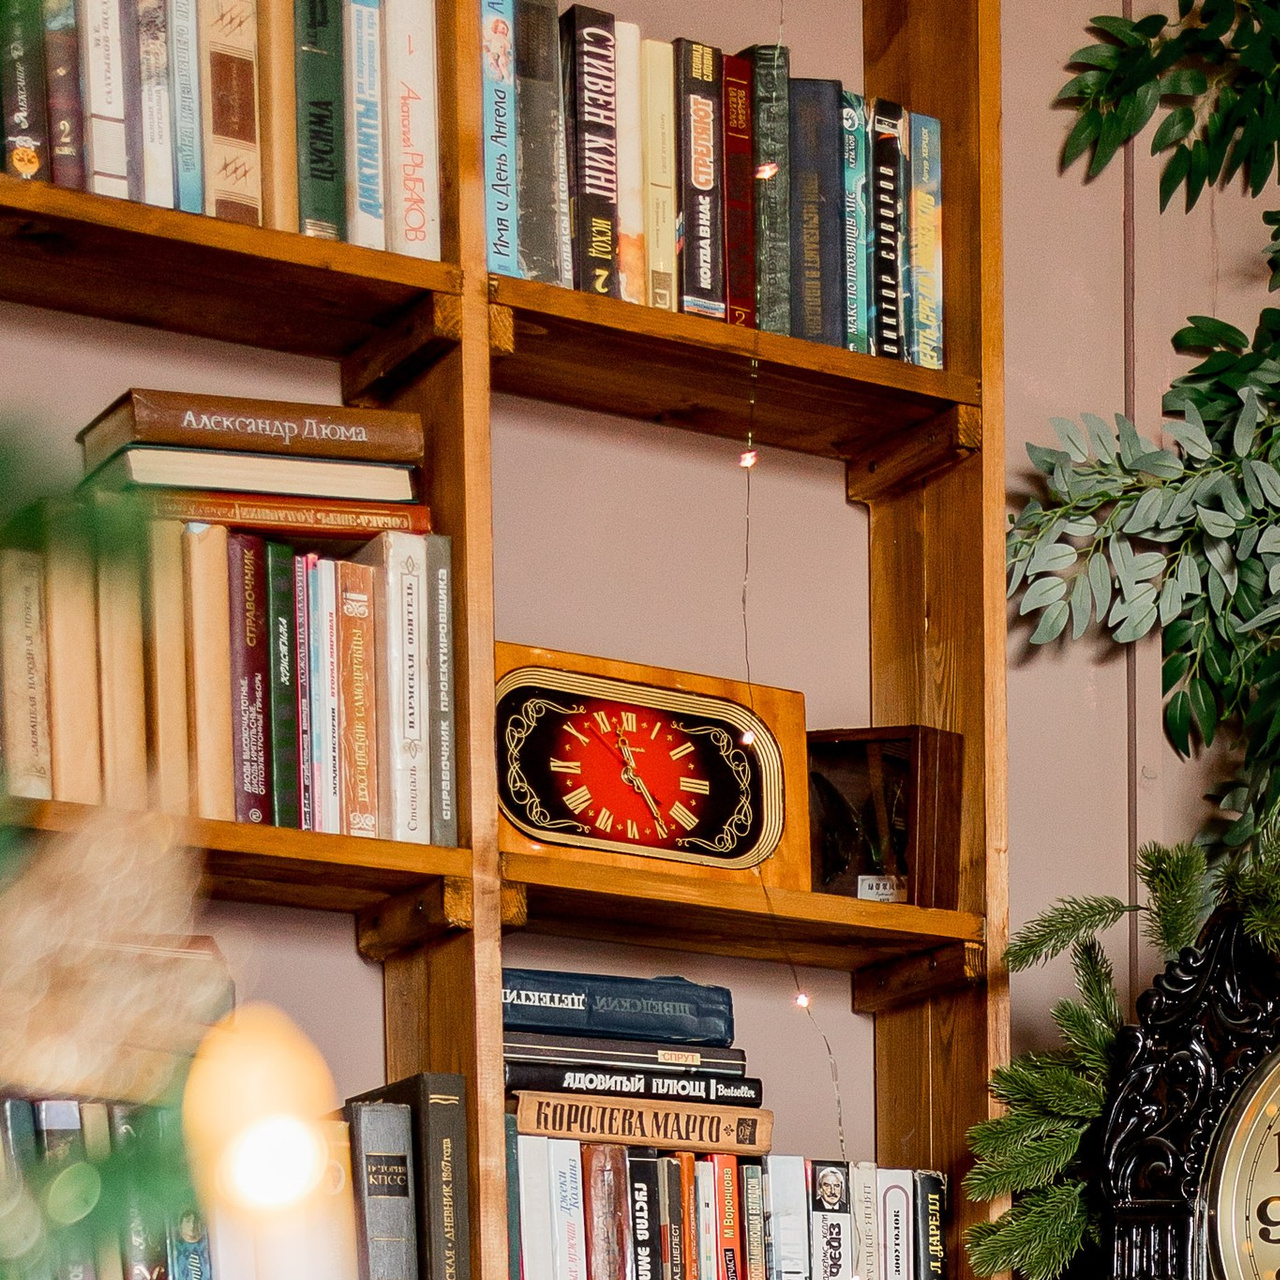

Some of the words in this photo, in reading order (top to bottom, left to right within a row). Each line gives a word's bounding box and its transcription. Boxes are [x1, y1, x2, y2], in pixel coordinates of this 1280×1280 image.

[583, 27, 615, 127] СТИВЕН
[691, 44, 702, 81] ЛЕОНИД
[702, 46, 712, 82] СЛОВИН
[307, 100, 338, 182] ЦУСИМА
[489, 88, 510, 149] Ангела
[355, 97, 383, 220] ДИКТАНТЫ
[690, 94, 714, 190] СТРЕЛЯЮТ
[491, 153, 512, 197] День
[584, 131, 617, 204] КИНГ
[402, 152, 427, 242] РЫБАКОВ
[496, 202, 509, 213] и
[698, 195, 710, 226] НАС
[845, 192, 856, 216] ЛИС
[879, 164, 895, 260] СУВОРОВ
[492, 218, 511, 257] Имя
[561, 215, 573, 279] КОЛБАСЫ
[588, 217, 612, 260] ИСХОД
[699, 227, 710, 237] В
[846, 217, 858, 280] ПРОЗВИЩУ
[593, 268, 610, 293] 2
[699, 239, 712, 289] КОГДА
[846, 281, 857, 298] ПО
[846, 302, 858, 335] МАКС
[882, 276, 897, 354] ВИКТОР
[181, 410, 298, 445] Александр
[302, 419, 368, 442] Дюма
[244, 549, 257, 647] СПРАВОЧНИК
[405, 582, 414, 645] ОБИТЕЛЬ
[26, 635, 36, 690] НАРОДНАЯ
[255, 672, 263, 712] ПРИБОРЫ
[405, 653, 415, 730] ПАРМСКАЯ
[243, 761, 252, 793] ДИОДЫ
[256, 713, 266, 796] ОПТОЭЛЕКТРОННЫЕ
[354, 721, 370, 803] РОССИЙСКИЕ
[250, 762, 259, 794] ДИОДЫ
[407, 765, 419, 831] Стендаль
[502, 988, 586, 1010] ДЕТЕКТИ
[595, 995, 691, 1016] ШВЕДСКИЙ
[661, 1051, 697, 1063] СПРУТ
[563, 1071, 645, 1094] ЯДОВИТЫЙ
[652, 1078, 706, 1097] ПЛЮЩ
[717, 1083, 755, 1098] Bestseller
[536, 1100, 650, 1138] КОРОЛЕВА
[649, 1109, 721, 1143] МАРГО
[369, 1174, 407, 1185] КПСС
[558, 1171, 572, 1217] Джеки
[568, 1158, 580, 1210] Коллинз
[748, 1178, 760, 1215] ВЗГЛЯДОМ
[442, 1183, 455, 1241] ДНЕВНИК
[634, 1182, 651, 1241] ГУСТАВ
[820, 1214, 829, 1240] ХЕДЛИ
[927, 1193, 944, 1275] Л.ДАРЕЛЛ
[565, 1221, 581, 1264] мужчин
[826, 1222, 843, 1278] ЧЕЙЗ
[893, 1209, 901, 1276] ЗООУГОЛОК
